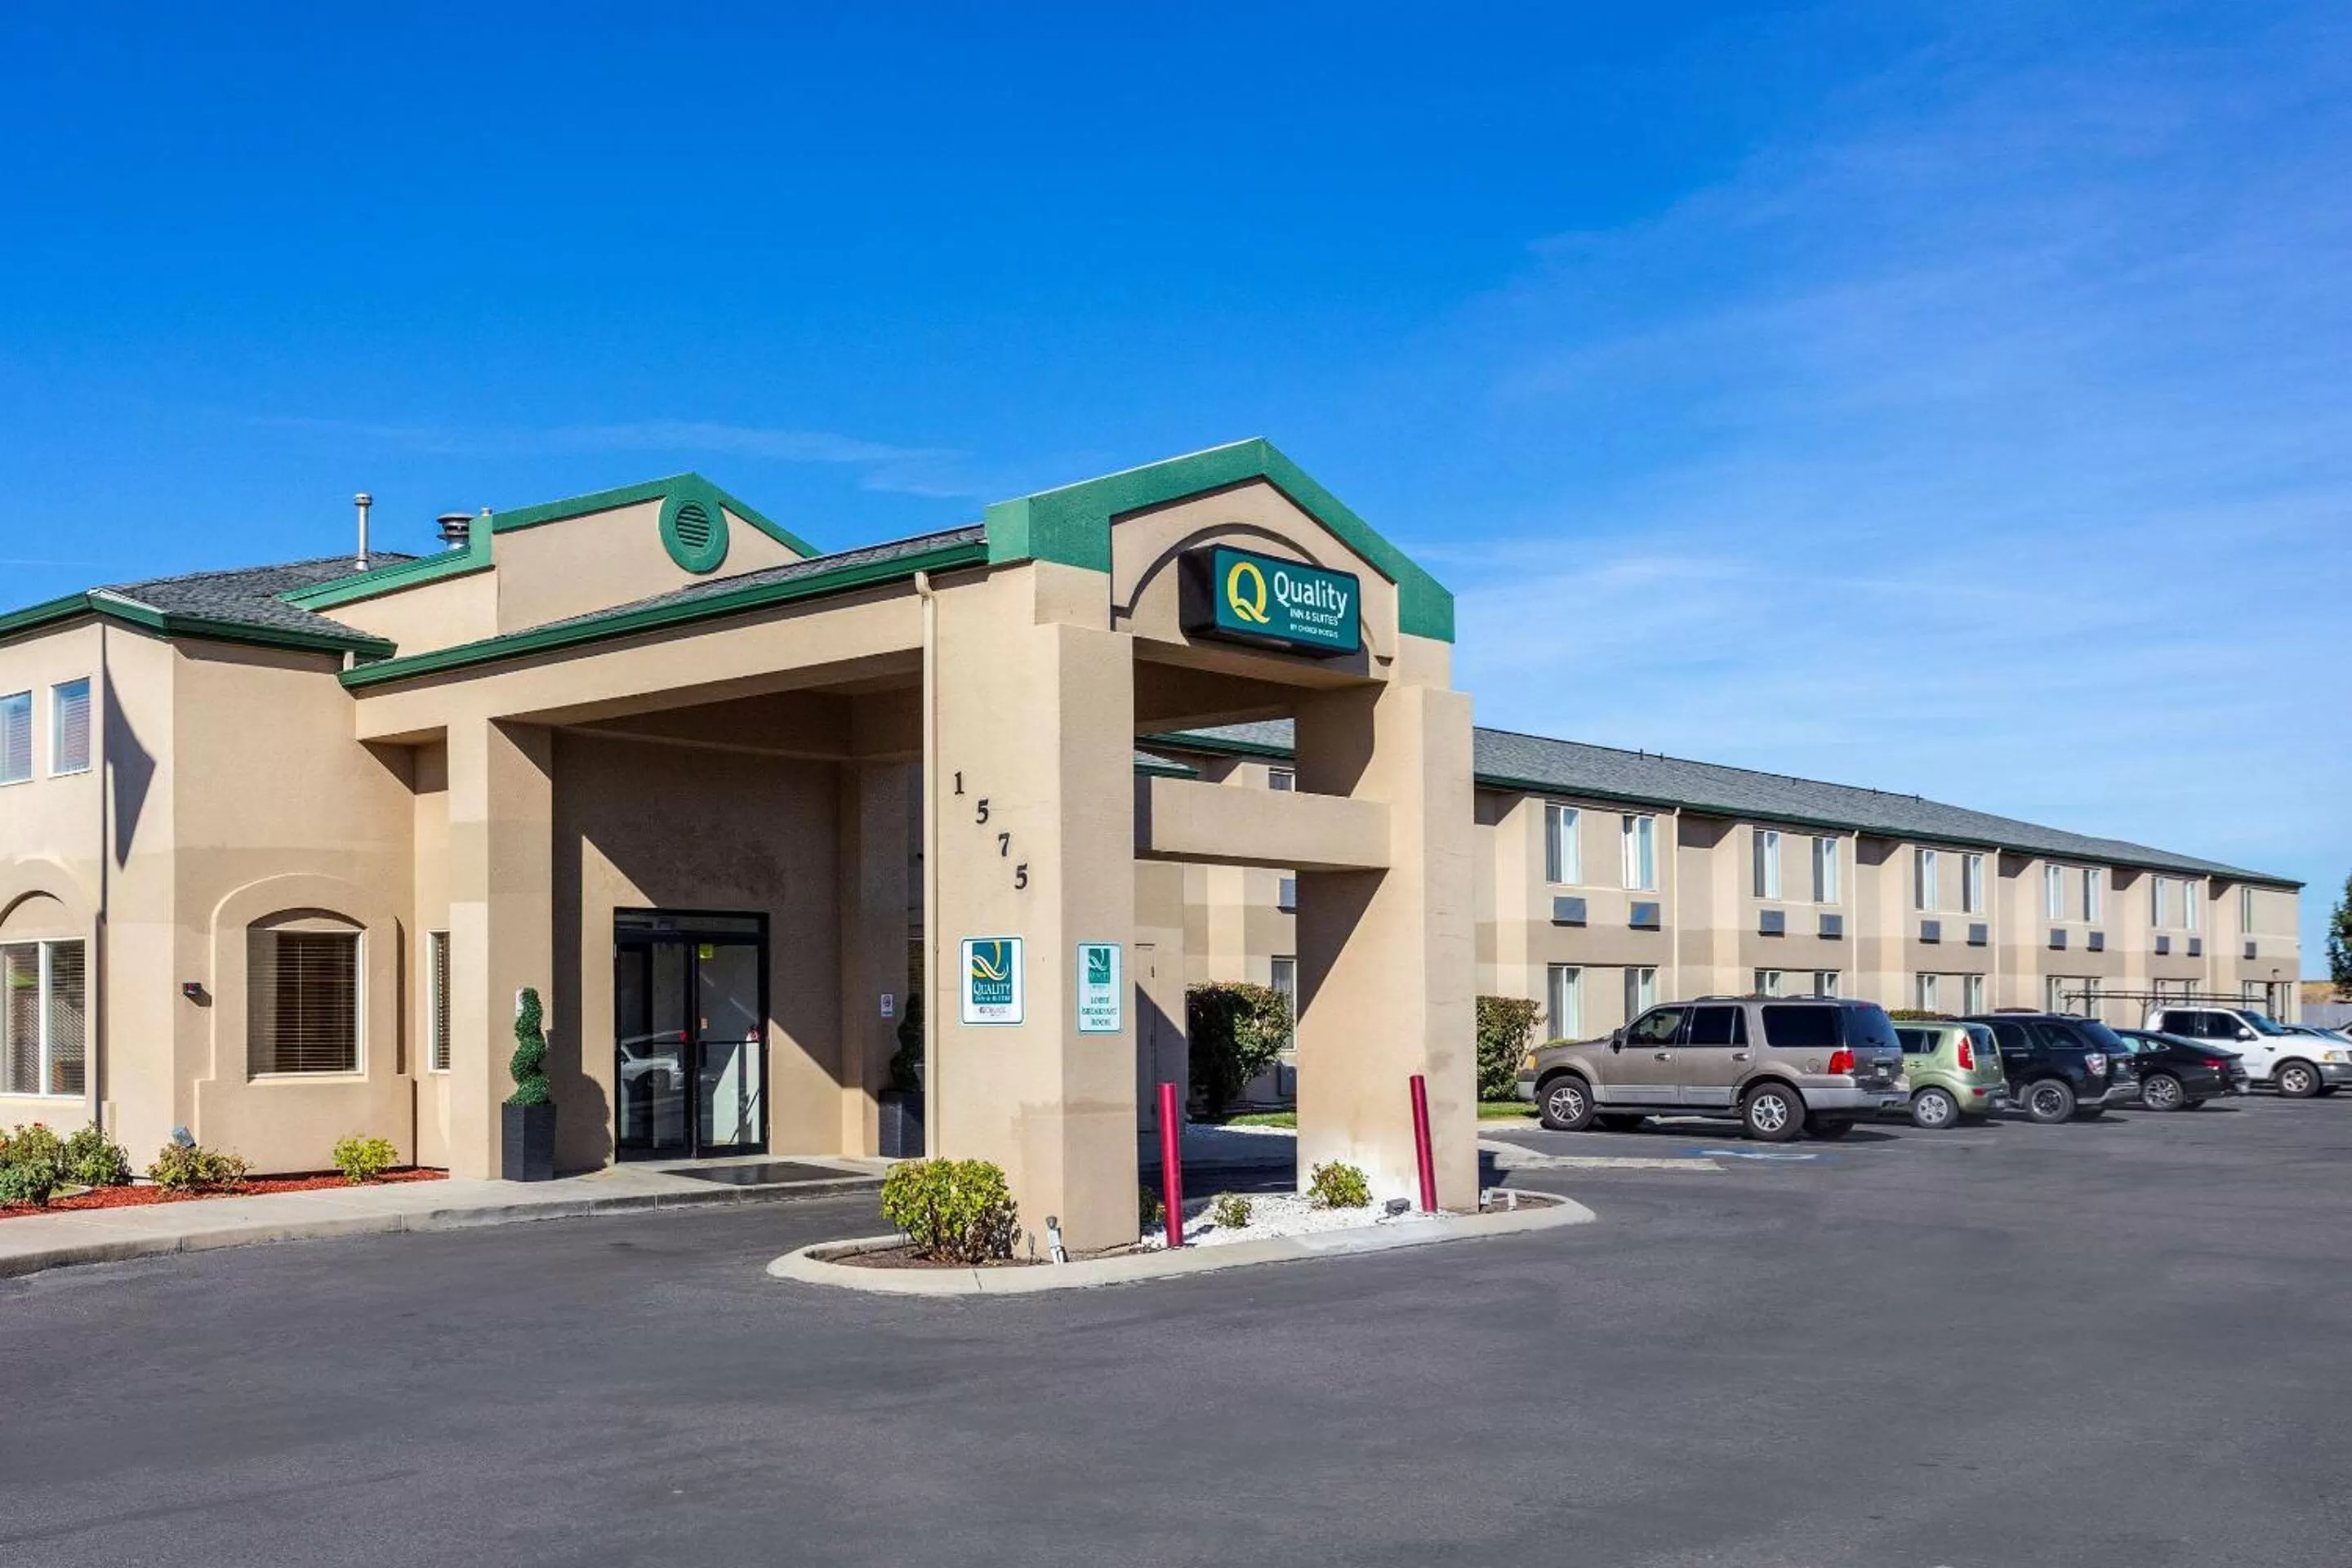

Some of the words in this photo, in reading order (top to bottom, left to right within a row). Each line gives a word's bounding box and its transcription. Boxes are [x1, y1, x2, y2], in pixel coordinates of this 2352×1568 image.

[1274, 571, 1347, 618] Quality
[1290, 608, 1304, 620] INN
[1305, 610, 1311, 621] &
[1312, 612, 1339, 626] SUITES
[973, 981, 1010, 996] QUALITY
